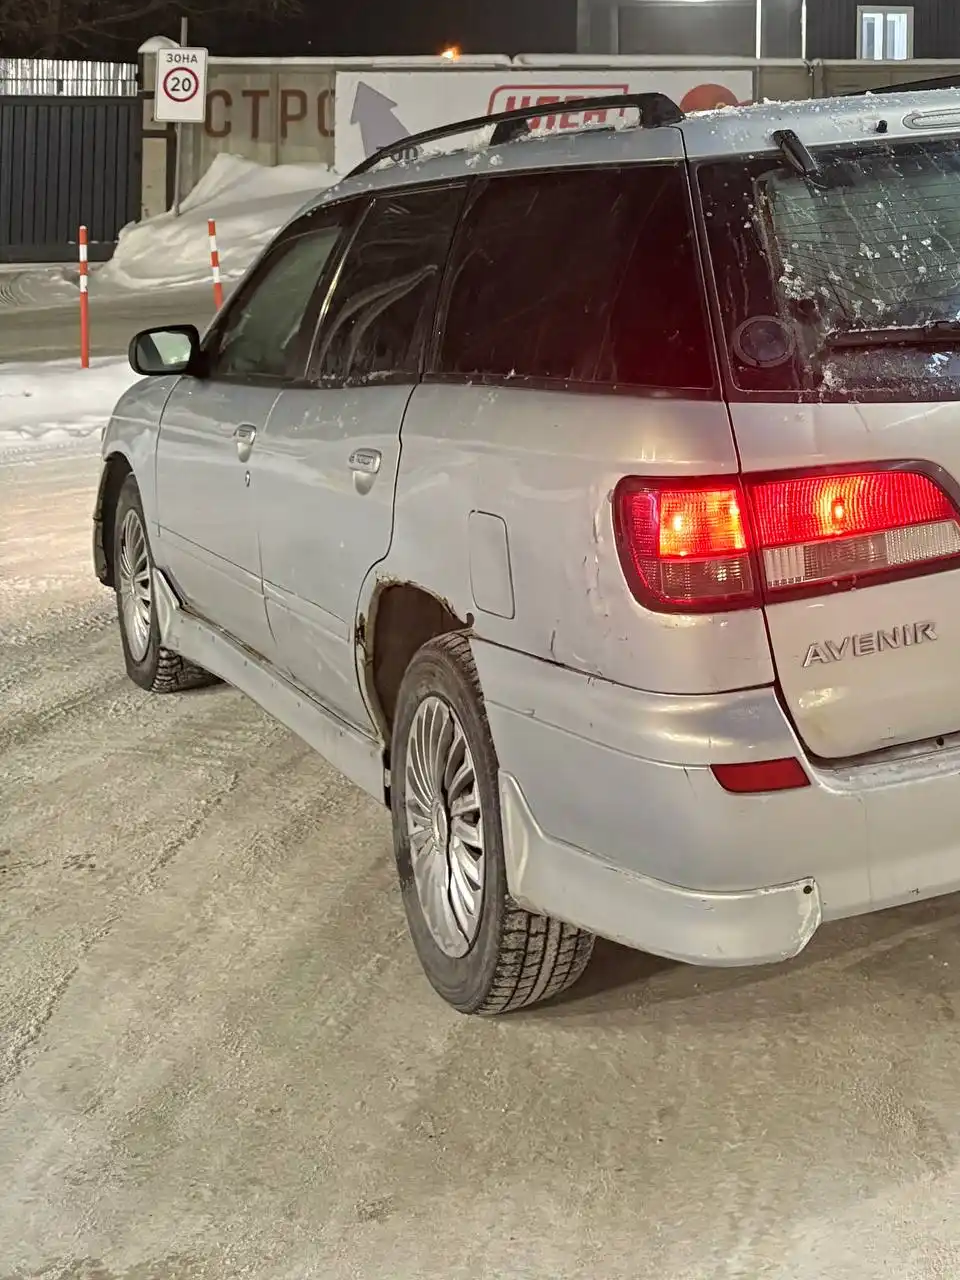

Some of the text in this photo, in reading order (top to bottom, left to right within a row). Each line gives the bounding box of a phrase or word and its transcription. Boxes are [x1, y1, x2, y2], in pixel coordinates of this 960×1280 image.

[166, 53, 198, 64] ЗОНА
[170, 77, 192, 92] 20
[801, 622, 938, 668] AVENIR
